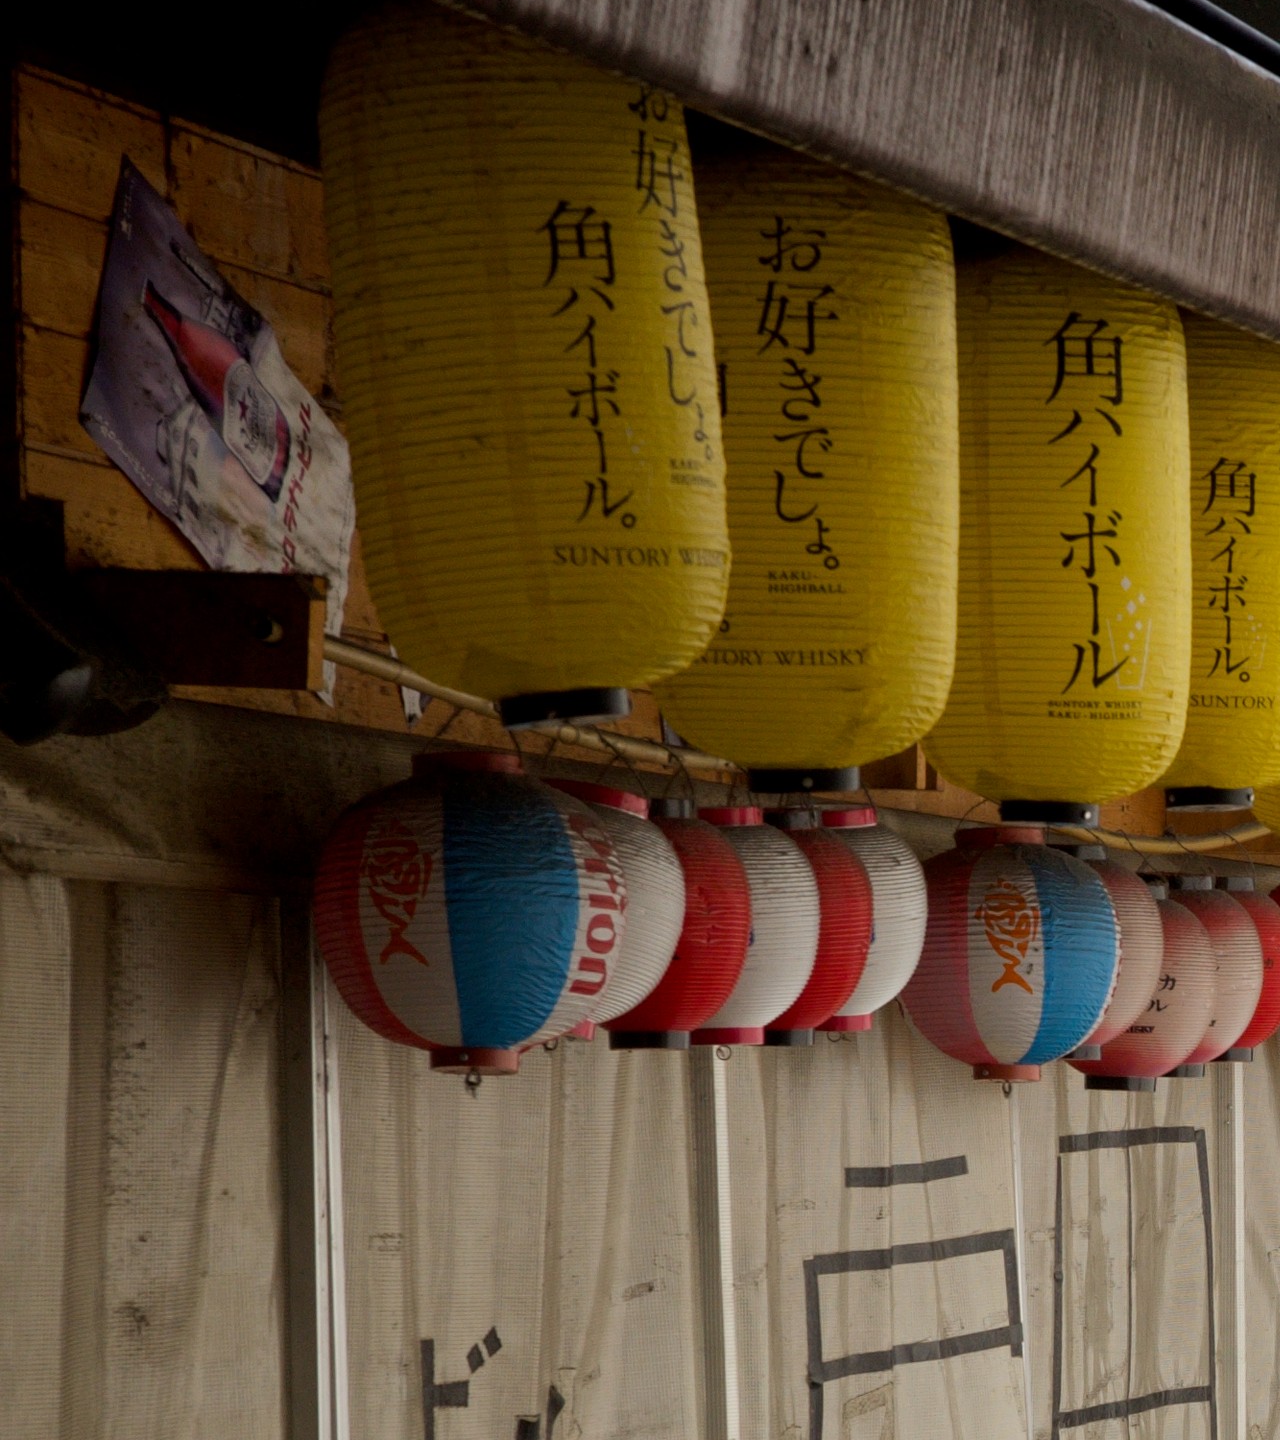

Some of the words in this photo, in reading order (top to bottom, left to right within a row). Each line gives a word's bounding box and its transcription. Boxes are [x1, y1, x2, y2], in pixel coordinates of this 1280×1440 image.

[534, 198, 638, 530] 角ハイボール。
[755, 214, 843, 572] お好きでしょ。
[553, 545, 672, 568] SUNTORY
[1042, 310, 1130, 696] 角ハイボール
[767, 583, 846, 595] HIGHBALL
[1201, 456, 1258, 684] 角ハイボール。
[772, 647, 869, 667] WHISKY
[1189, 693, 1276, 710] SUNTORY
